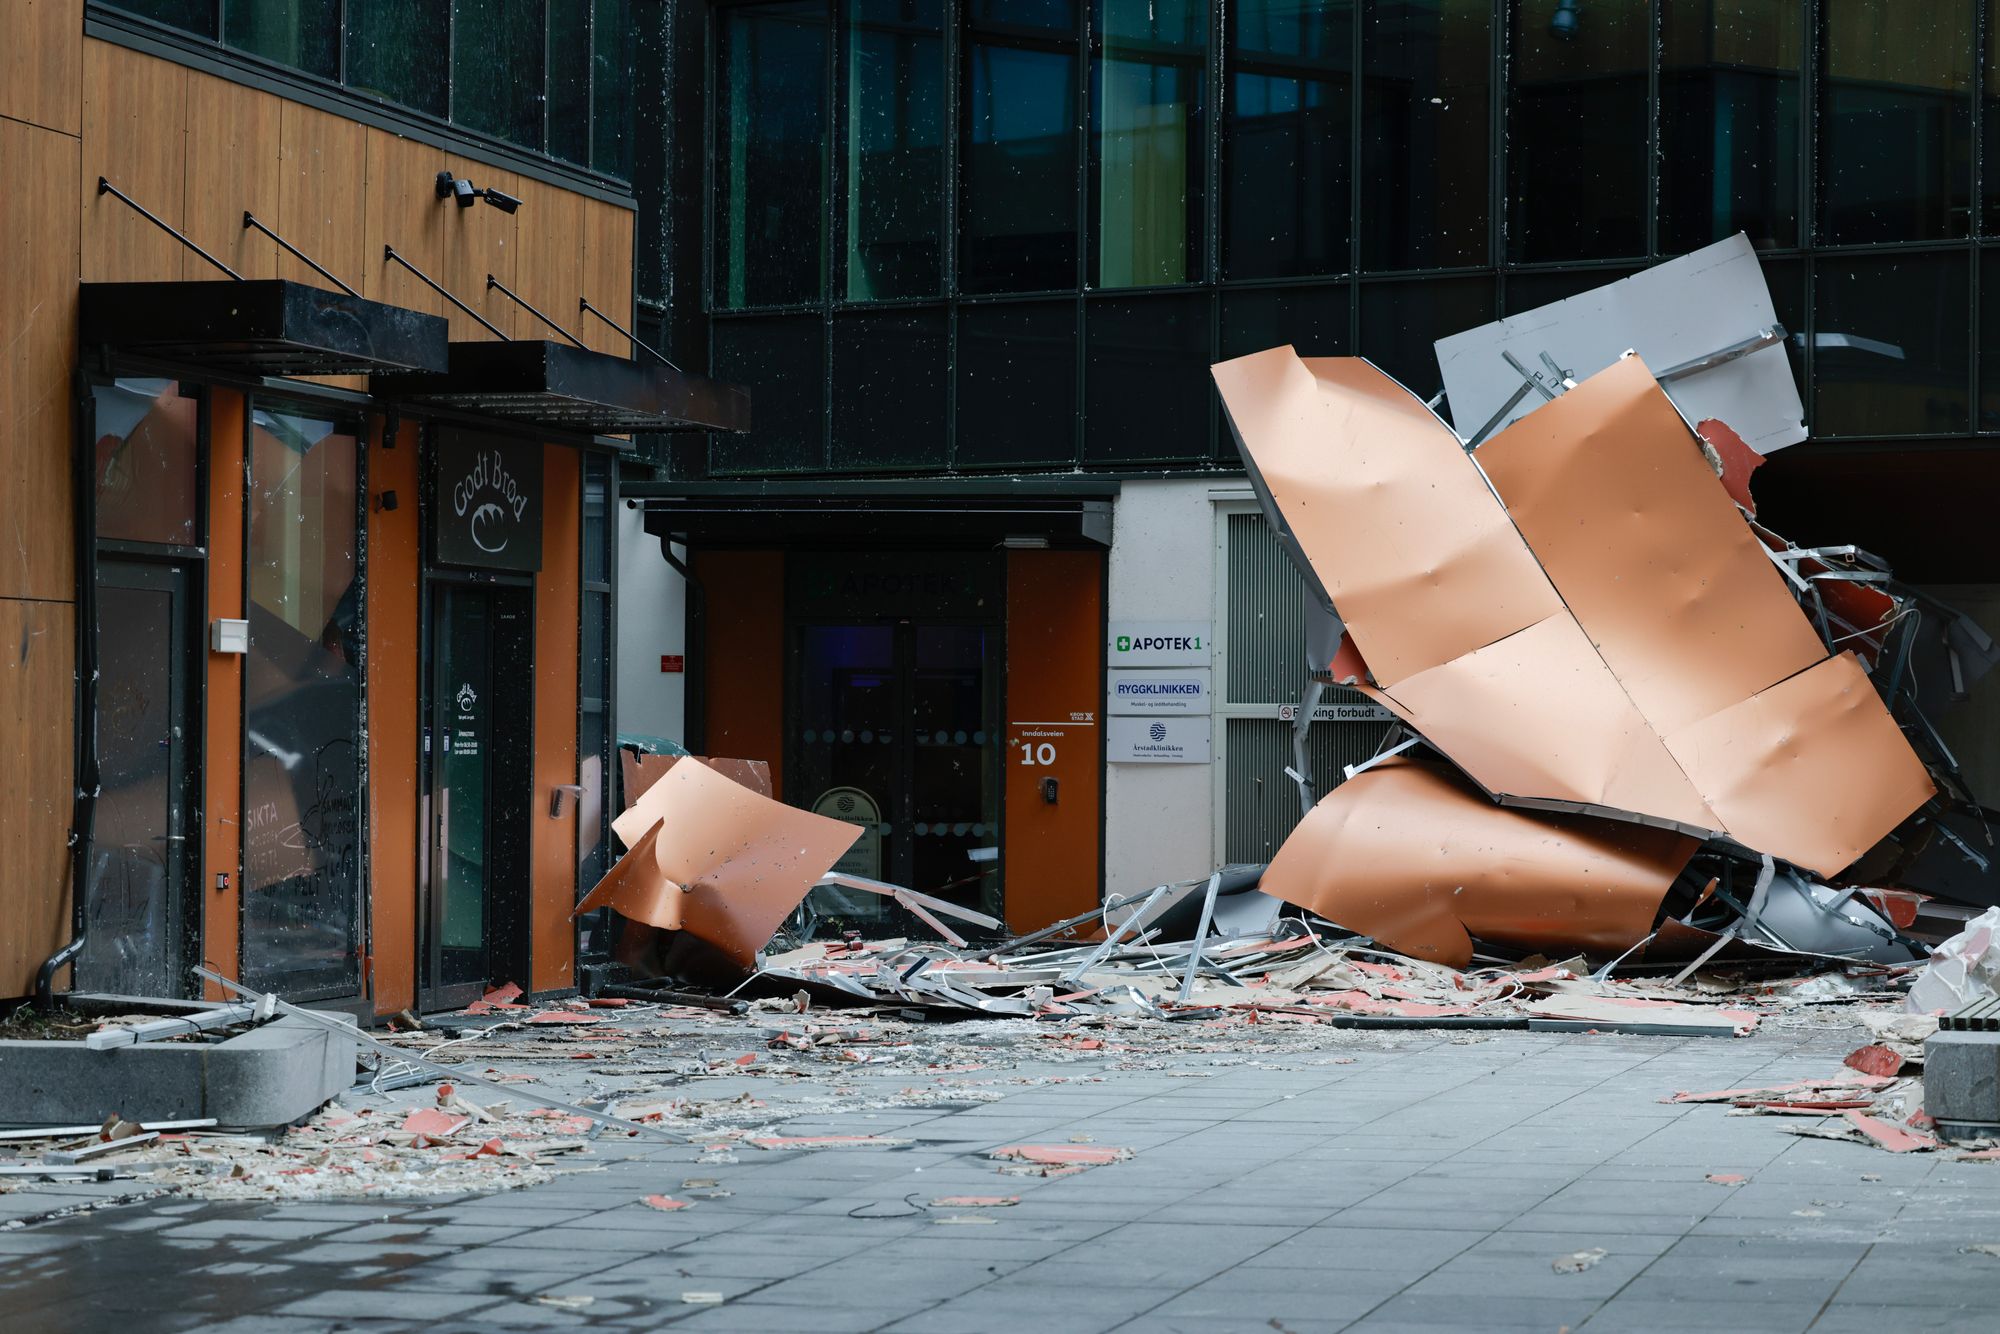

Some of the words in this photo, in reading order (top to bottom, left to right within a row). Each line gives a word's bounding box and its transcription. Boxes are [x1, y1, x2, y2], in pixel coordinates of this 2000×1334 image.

[454, 450, 488, 516] Godt
[492, 449, 528, 522] Brød
[840, 573, 957, 594] APOTEK
[1132, 637, 1192, 650] APOTEK
[1194, 637, 1202, 650] 1
[1118, 684, 1200, 694] RYGGKLINIKKEN
[1293, 707, 1335, 720] Rking
[1337, 707, 1375, 718] forbudt
[1021, 743, 1056, 765] 10
